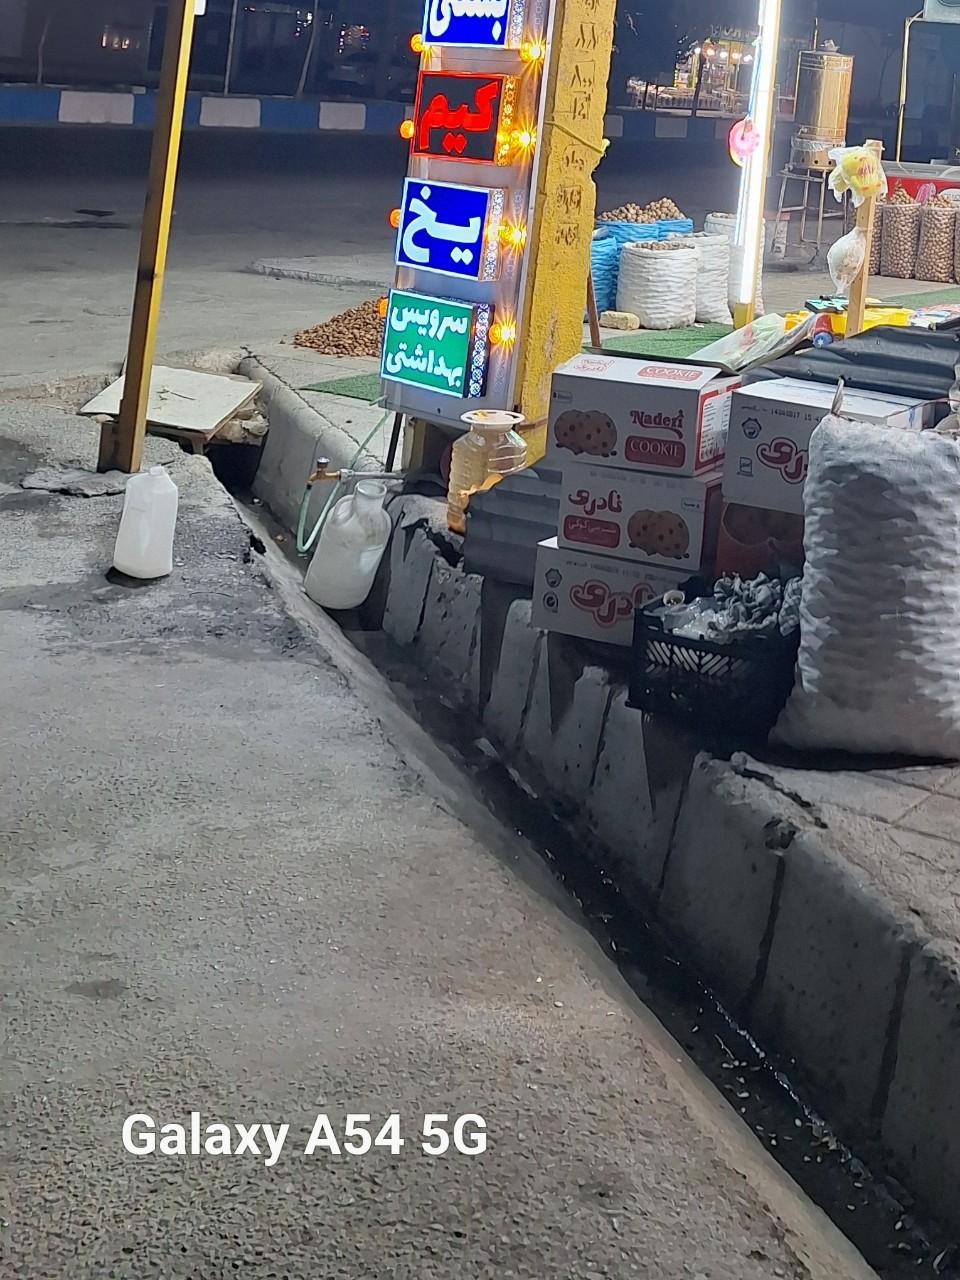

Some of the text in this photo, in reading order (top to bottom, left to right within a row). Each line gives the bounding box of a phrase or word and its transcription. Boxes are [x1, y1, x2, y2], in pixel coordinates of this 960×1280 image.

[403, 186, 483, 265] یخ
[391, 301, 469, 341] سرویس
[386, 343, 464, 388] بهداشتی
[646, 366, 700, 378] COOKIE
[630, 409, 685, 439] Naderi
[629, 439, 681, 458] COOKIE
[568, 489, 623, 516] نادری
[570, 580, 656, 625] ادری
